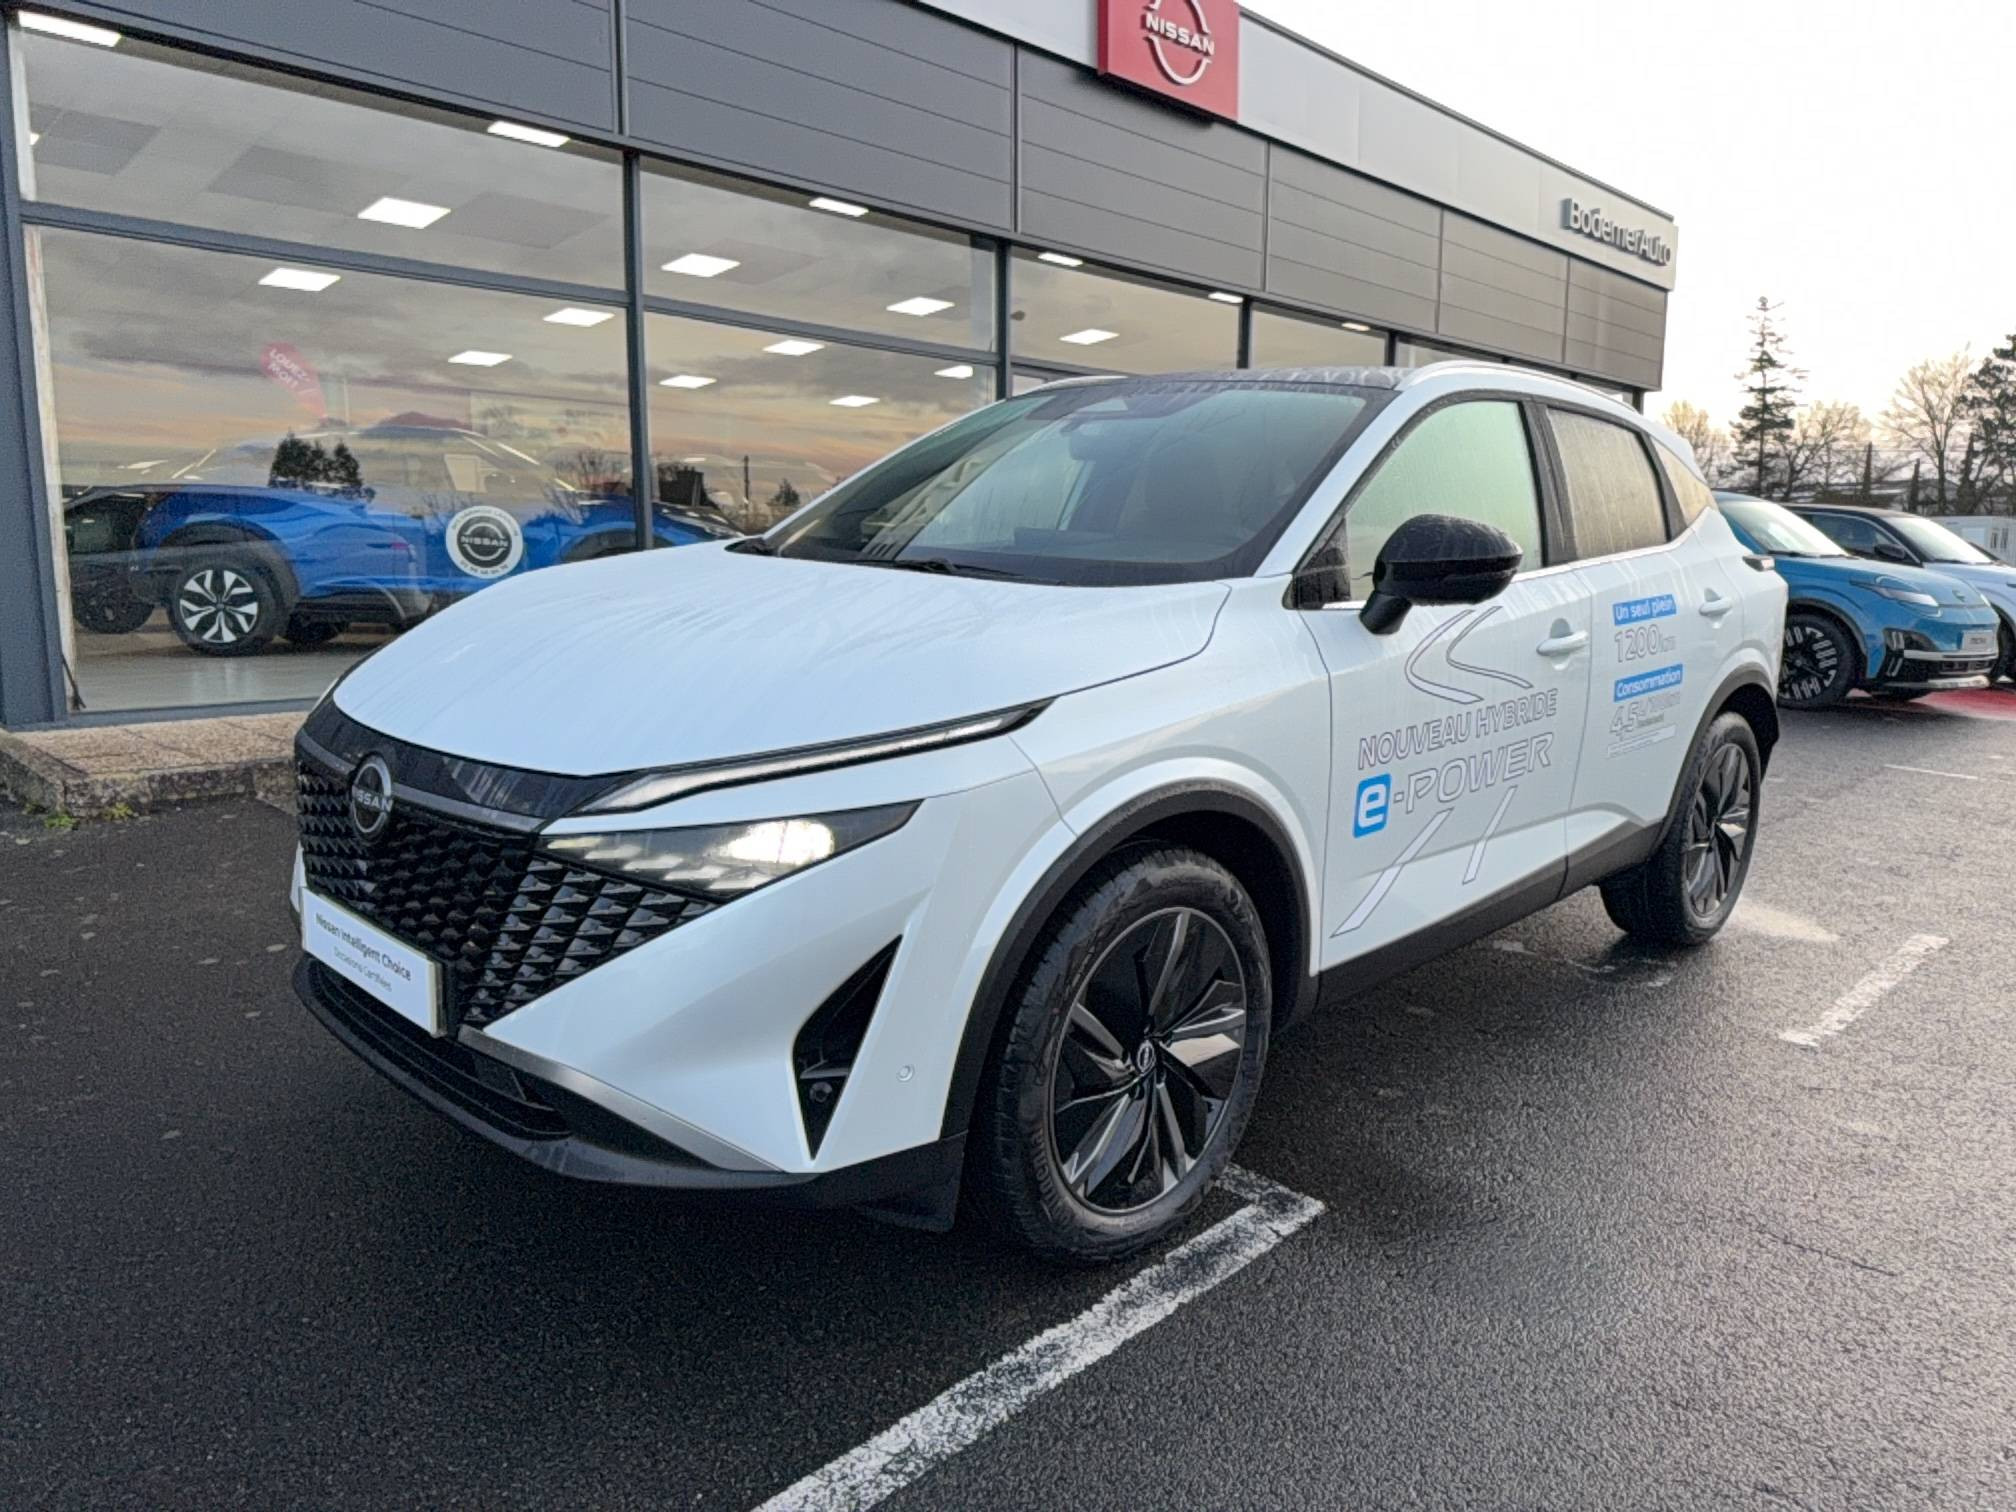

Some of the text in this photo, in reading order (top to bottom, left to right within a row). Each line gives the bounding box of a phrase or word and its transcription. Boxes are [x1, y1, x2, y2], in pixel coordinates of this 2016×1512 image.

[1145, 12, 1215, 56] NISSAN
[460, 535, 509, 548] NISSAN
[1615, 606, 1629, 620] Un
[1357, 688, 1558, 770] NOUVEAU HYBRIDE
[1355, 732, 1554, 832] e-POWER
[381, 954, 411, 982] Choice
